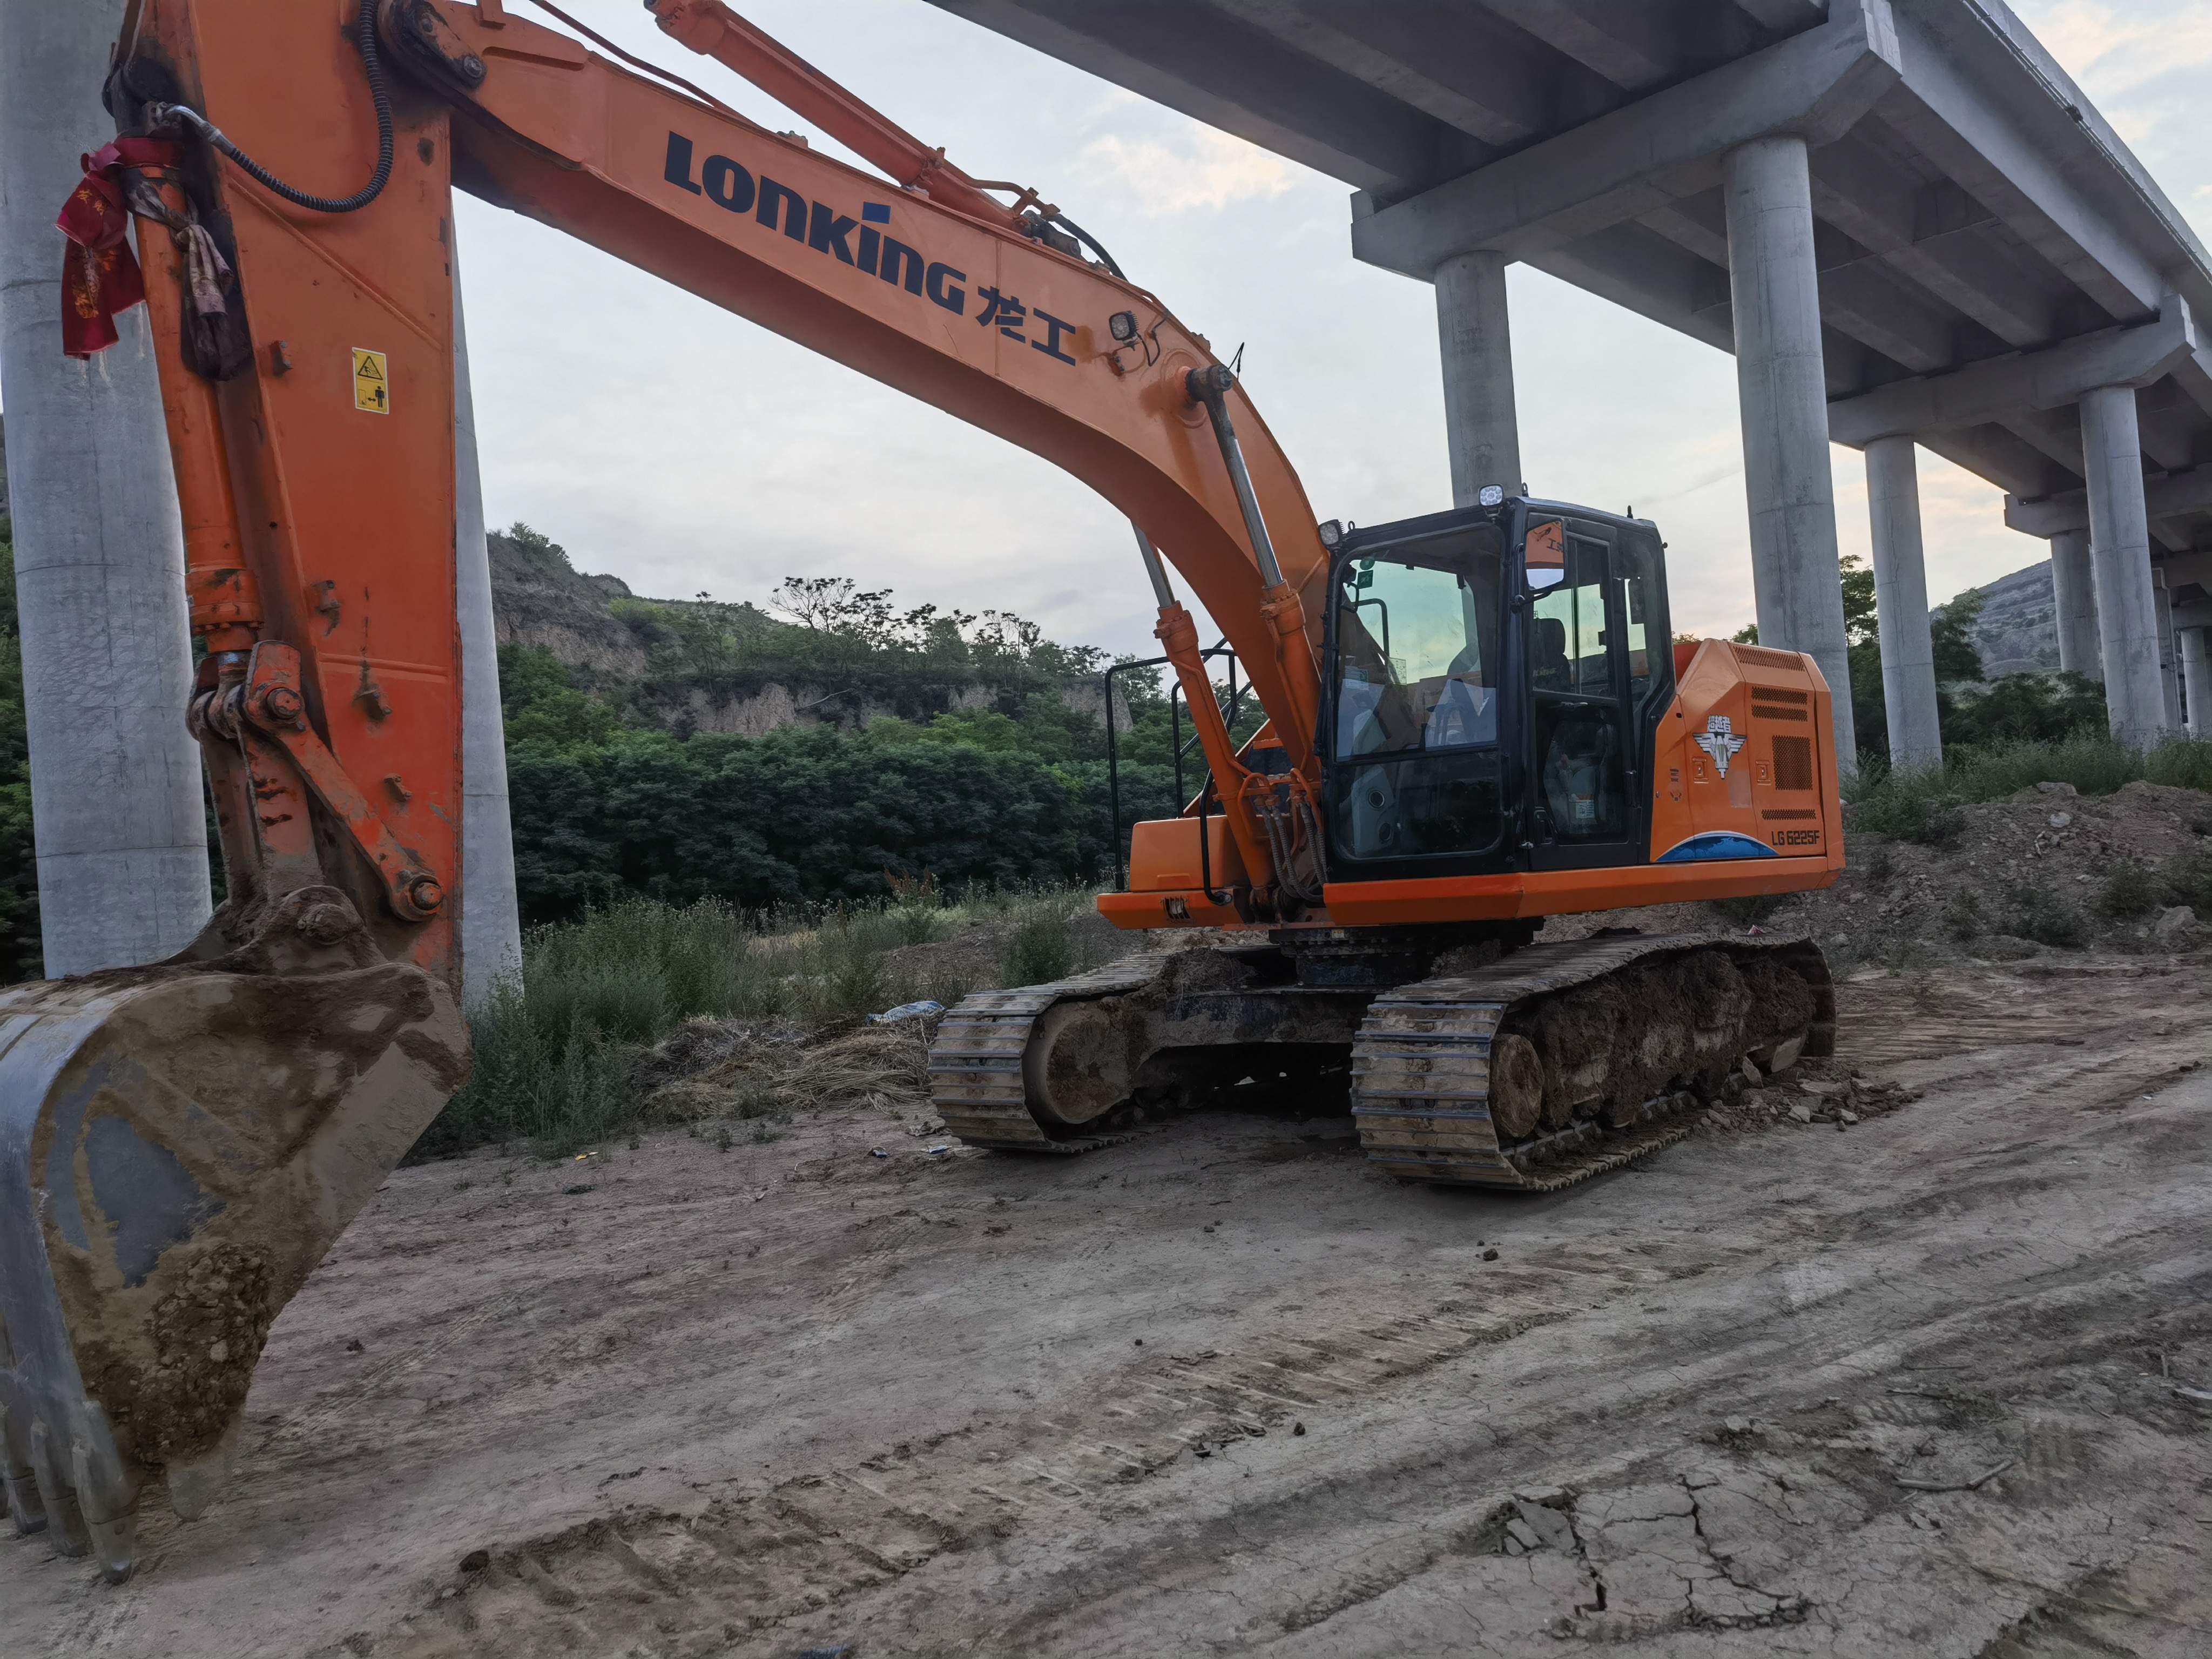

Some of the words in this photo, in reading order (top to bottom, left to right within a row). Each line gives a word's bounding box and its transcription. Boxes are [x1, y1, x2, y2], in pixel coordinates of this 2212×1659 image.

[976, 286, 1076, 366] 龙工
[1771, 831, 1785, 846] LG
[1787, 830, 1820, 845] 6225F
